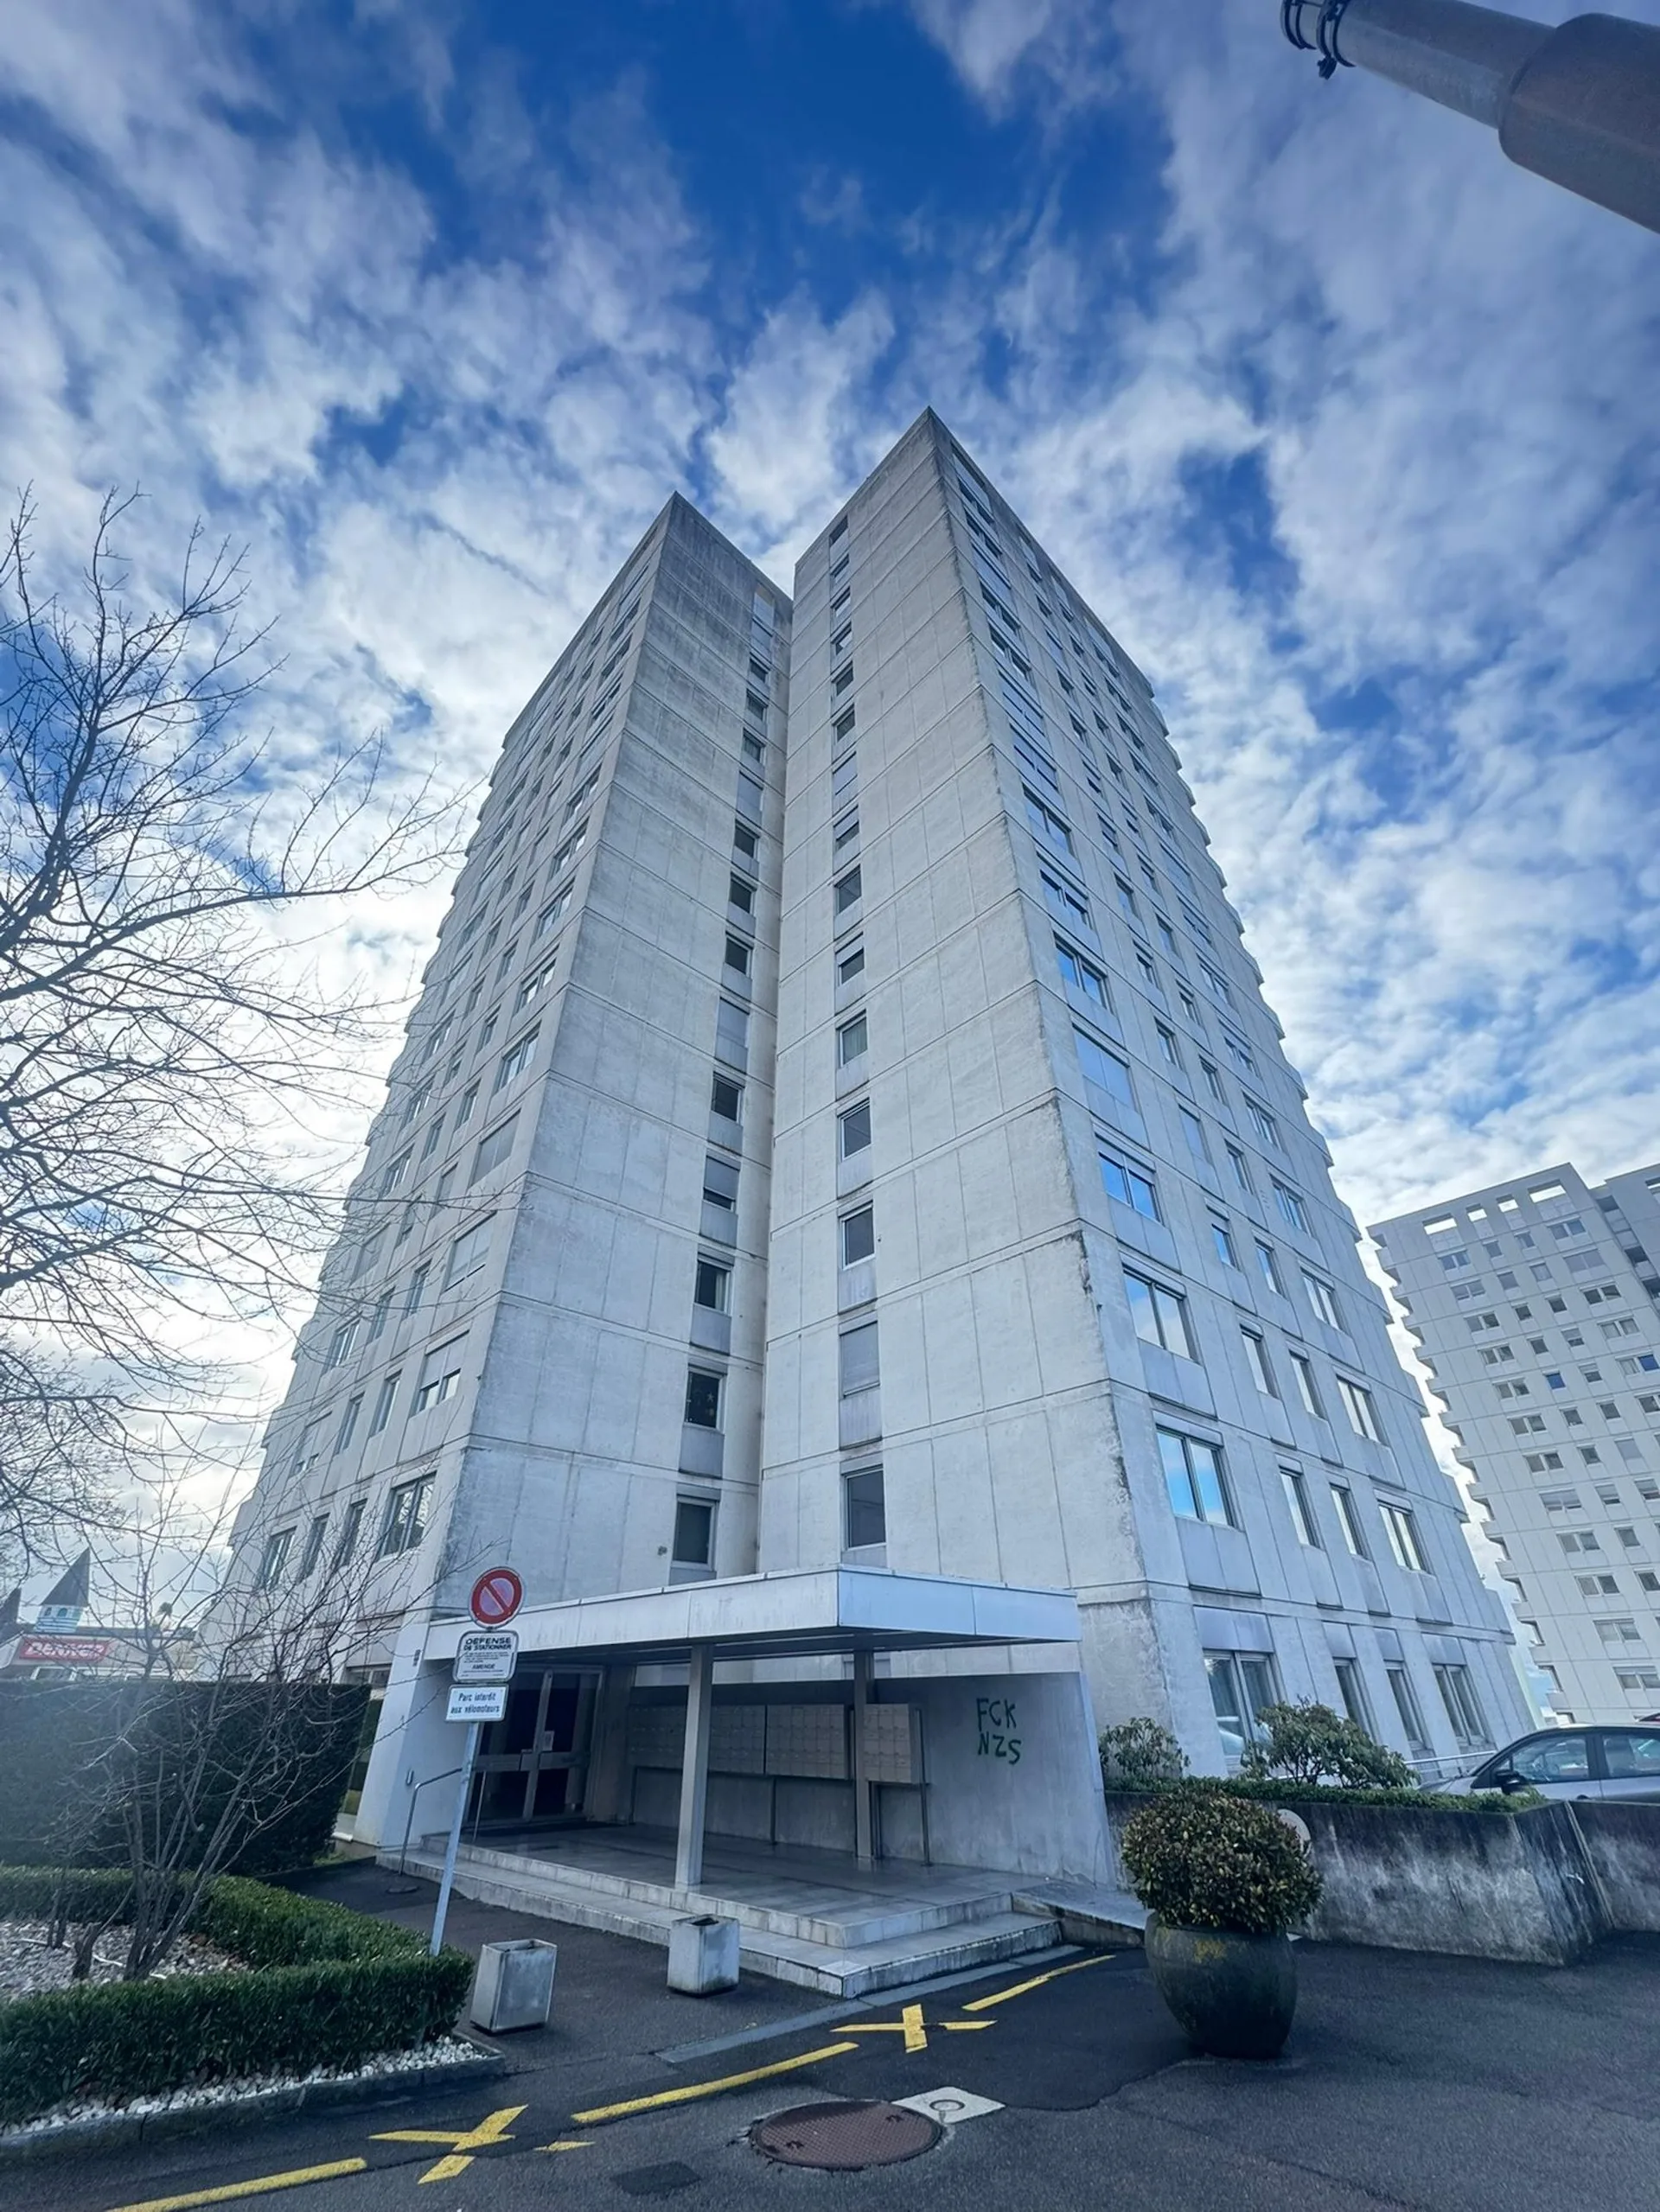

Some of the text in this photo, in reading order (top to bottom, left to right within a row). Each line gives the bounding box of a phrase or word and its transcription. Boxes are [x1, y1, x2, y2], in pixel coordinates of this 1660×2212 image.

[458, 1692, 496, 1701] Parc interdit
[976, 1698, 1017, 1731] FCK
[978, 1731, 1021, 1764] NZS
